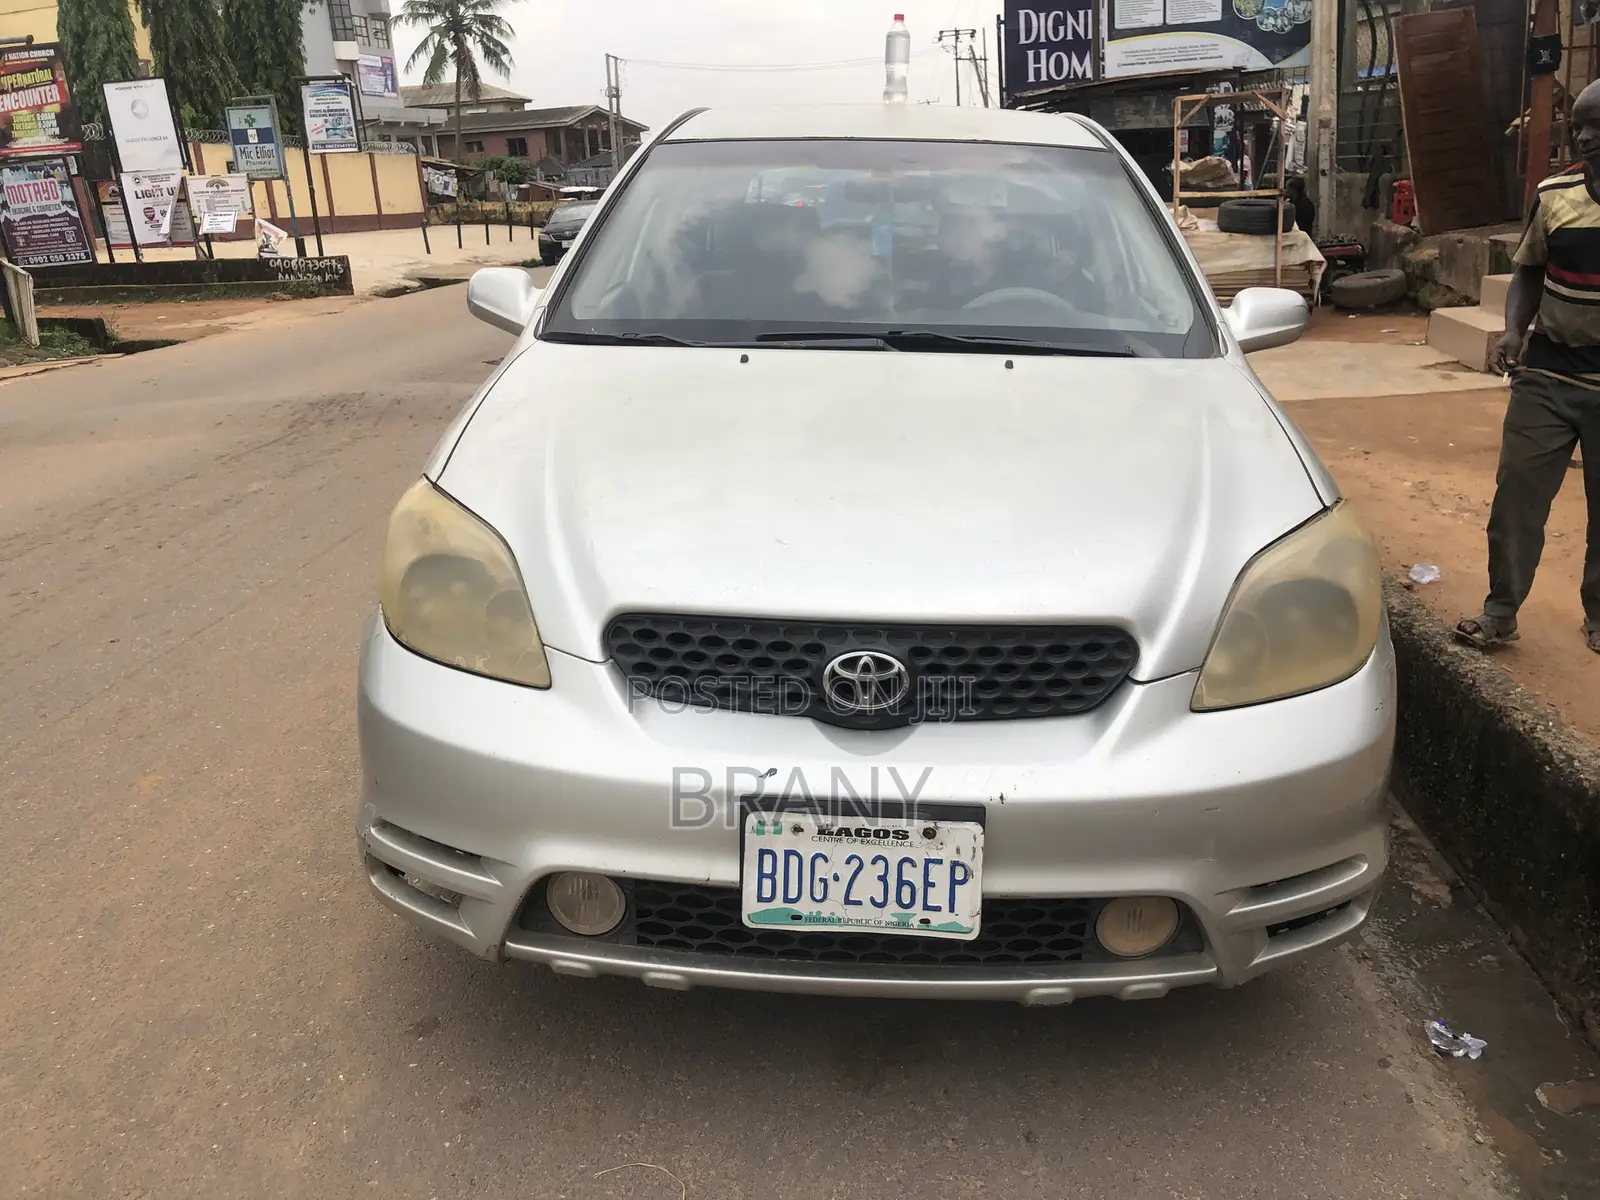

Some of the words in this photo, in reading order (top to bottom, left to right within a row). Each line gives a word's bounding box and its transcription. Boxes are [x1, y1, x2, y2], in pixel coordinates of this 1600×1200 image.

[30, 49, 55, 58] CHURCH
[1026, 49, 1093, 82] HOM
[0, 68, 53, 92] UPERNATURAL
[239, 146, 253, 160] Mic
[255, 145, 275, 160] Elliot
[6, 180, 60, 205] MOTAYO
[134, 187, 164, 200] LIGHT
[36, 203, 61, 213] COSMETICS
[817, 827, 910, 840] LAGOS
[811, 836, 844, 844] CENTRE
[860, 838, 915, 848] EXCELLENCE
[804, 916, 838, 924] FEDERAL
[838, 917, 872, 926] REPUBLIC
[884, 920, 915, 928] NIGERIA
